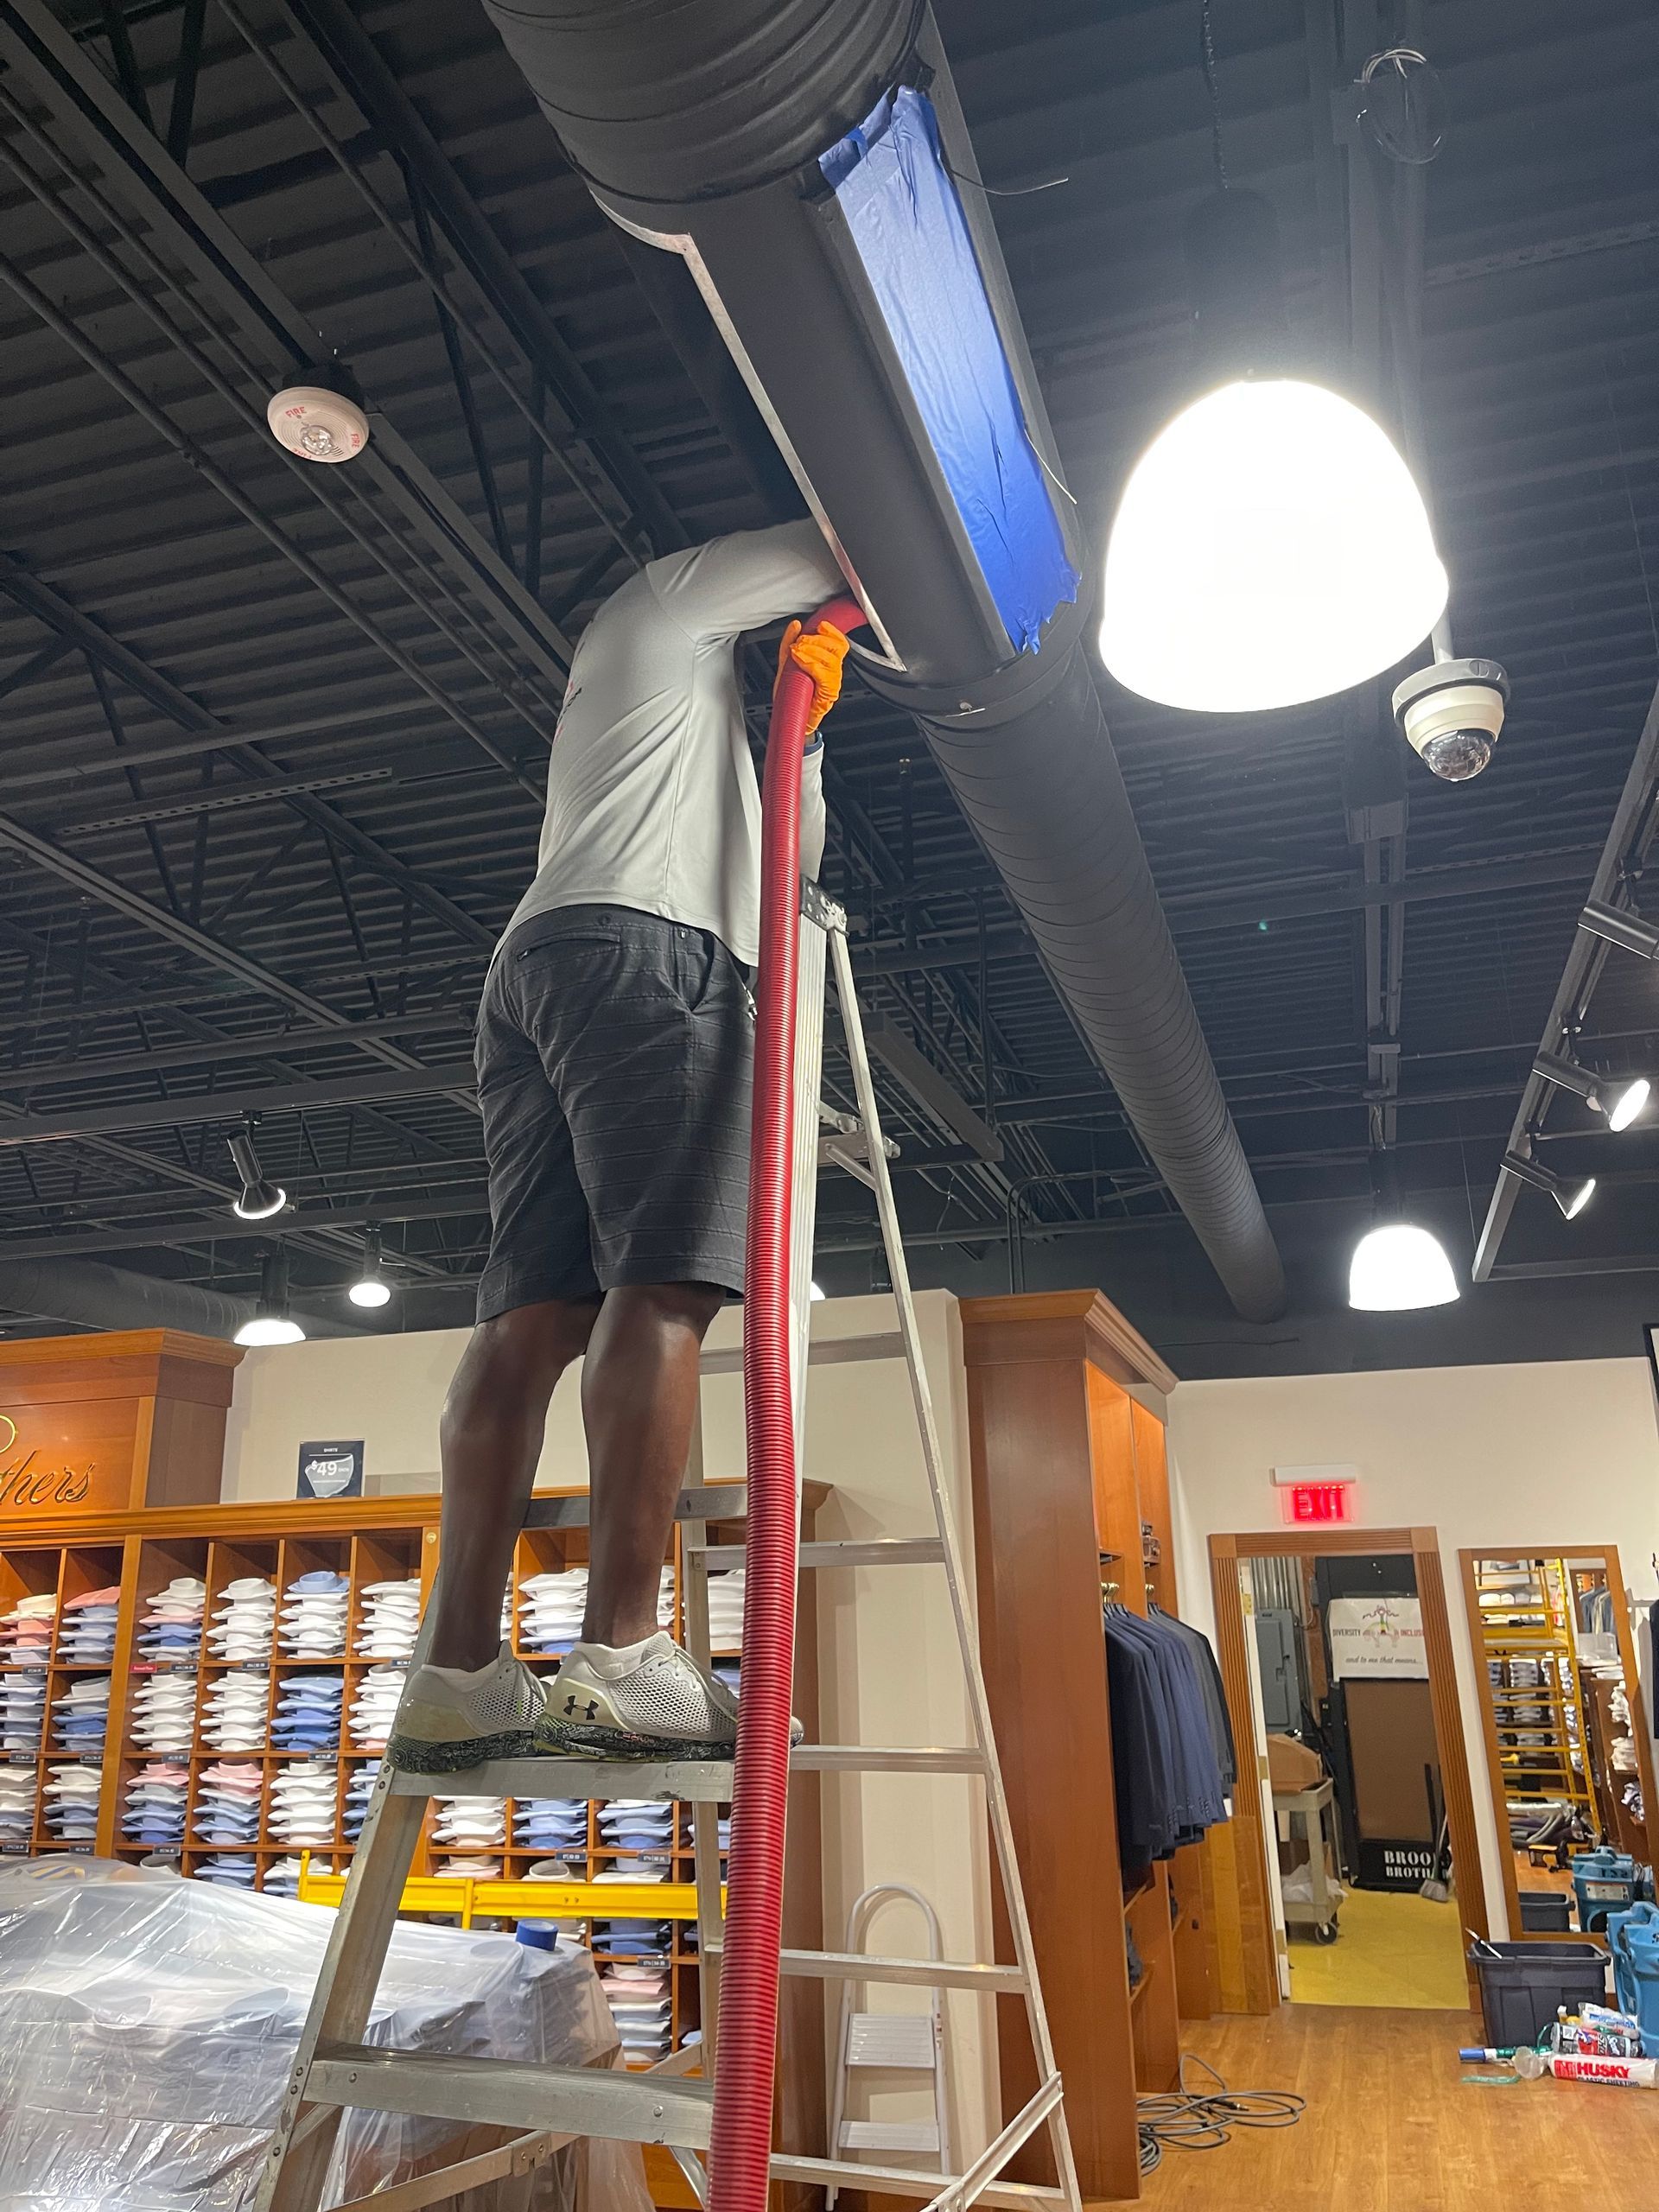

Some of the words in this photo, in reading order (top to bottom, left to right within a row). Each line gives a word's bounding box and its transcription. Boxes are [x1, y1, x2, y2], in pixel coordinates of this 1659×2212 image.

[285, 407, 306, 417] FIRE
[351, 433, 361, 448] FIRE
[311, 1459, 337, 1477] $49
[1292, 1485, 1344, 1522] EXIT
[1383, 1850, 1435, 1866] BROO
[1385, 1866, 1434, 1879] BROTH
[1577, 2062, 1632, 2080] HUSKY
